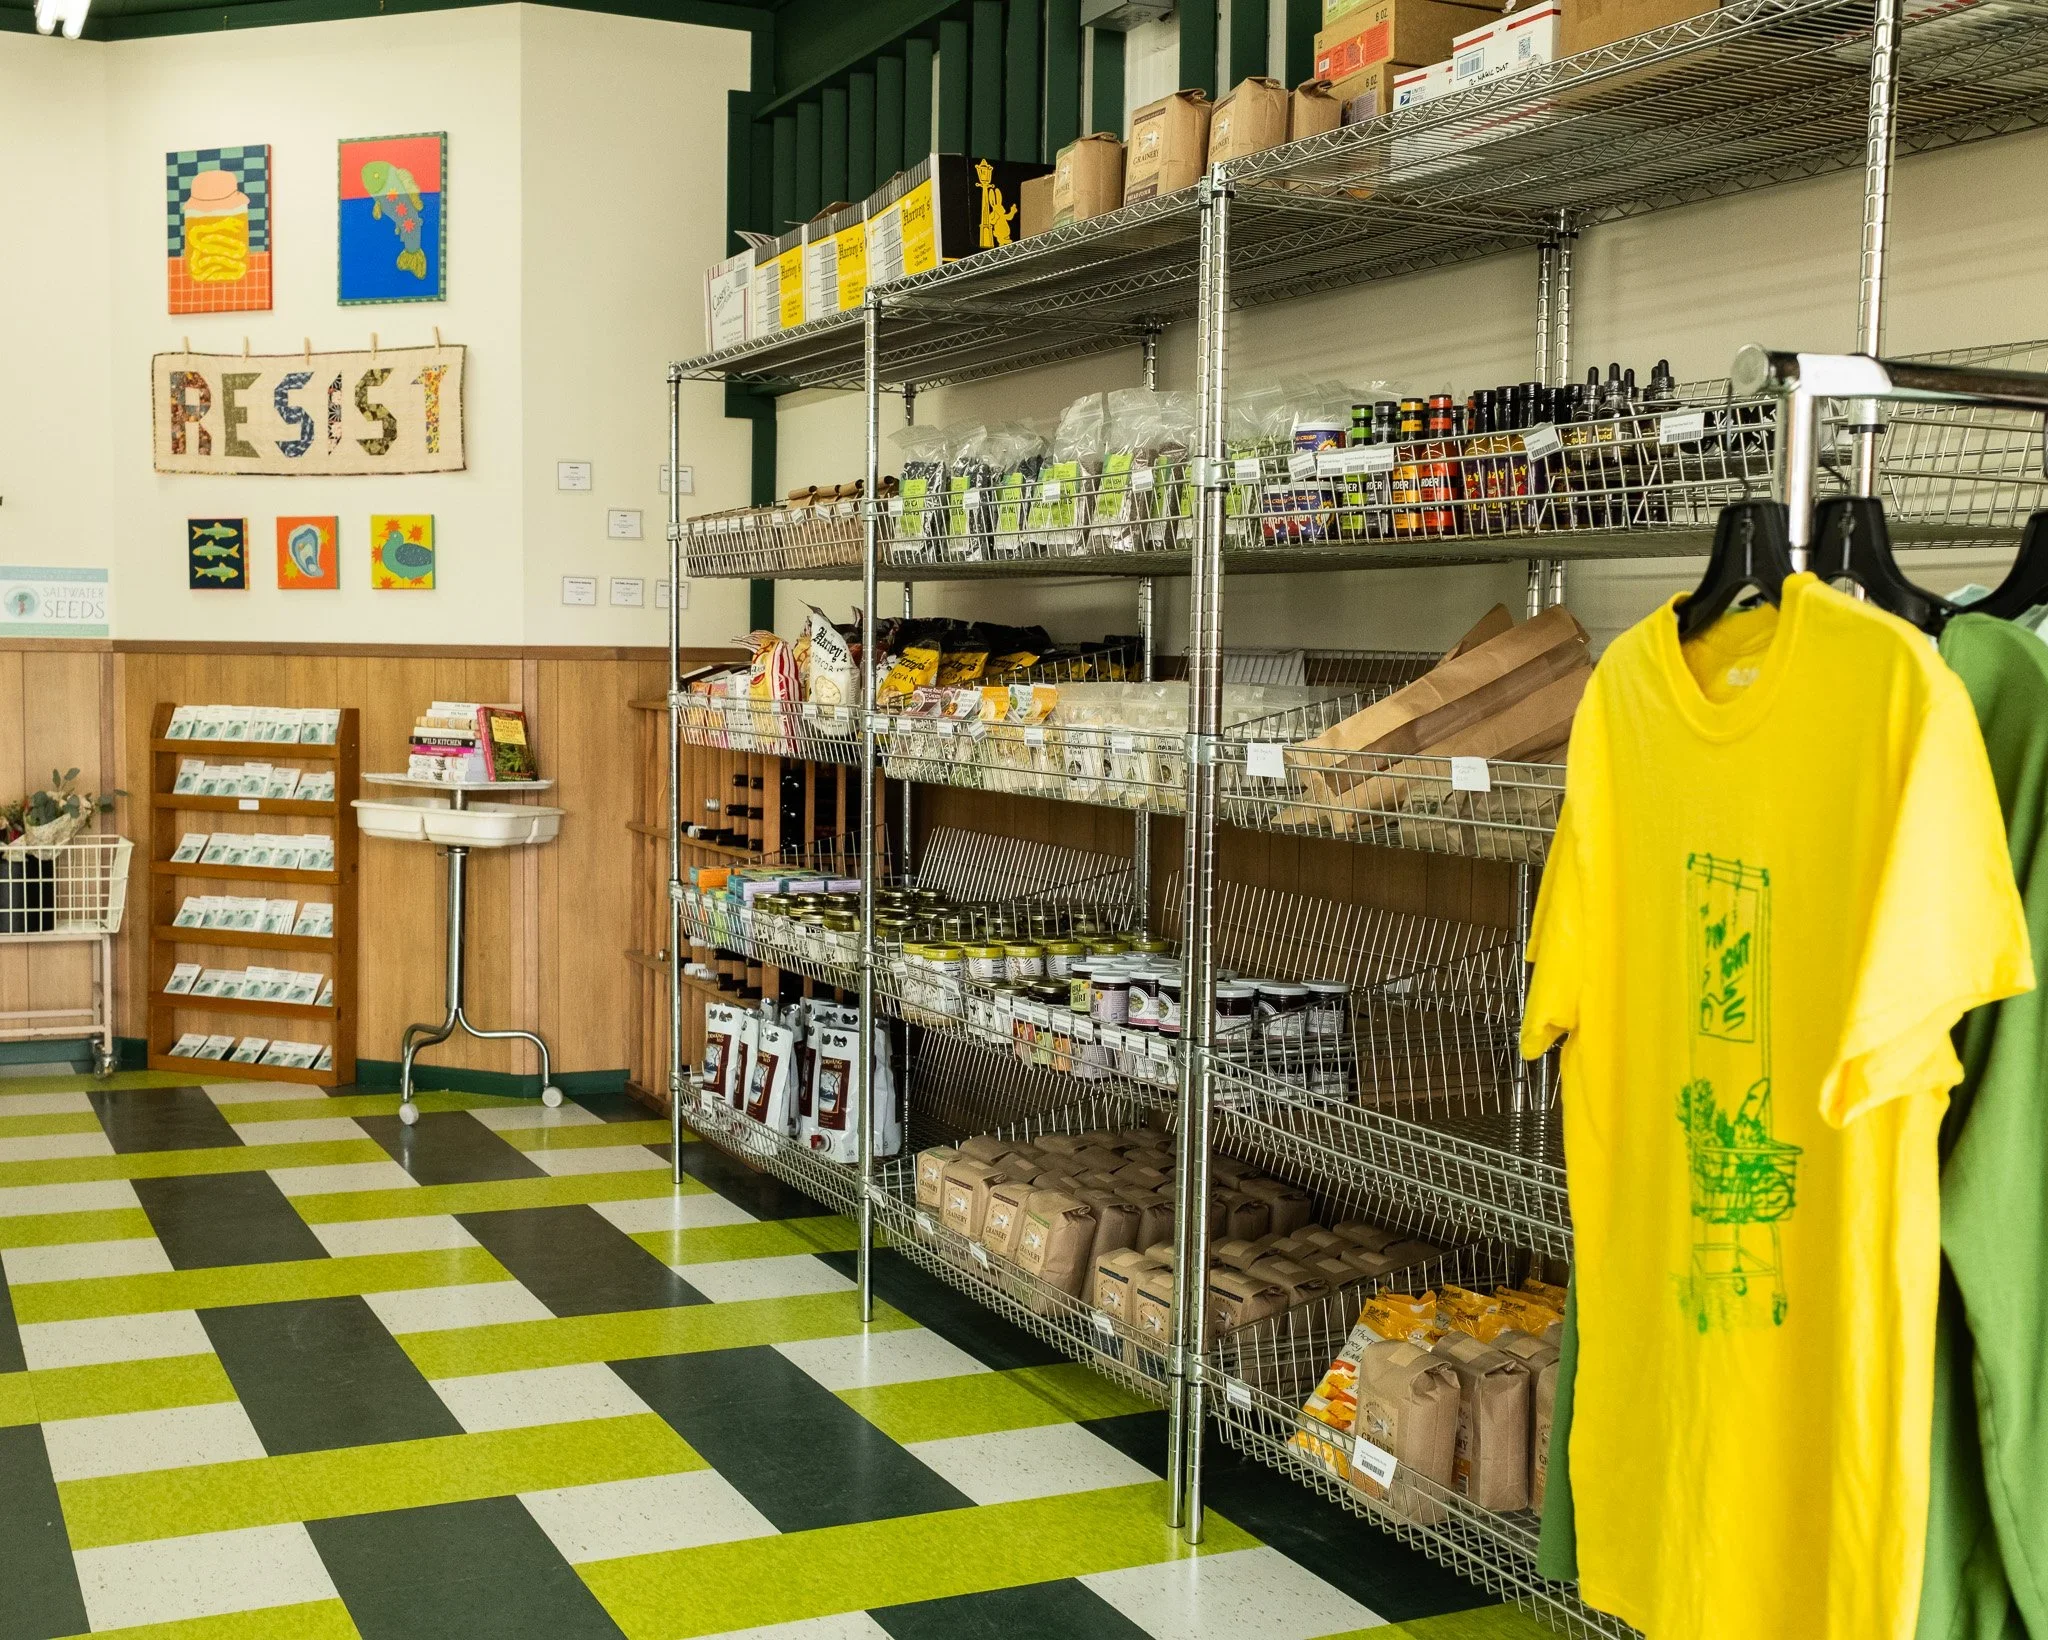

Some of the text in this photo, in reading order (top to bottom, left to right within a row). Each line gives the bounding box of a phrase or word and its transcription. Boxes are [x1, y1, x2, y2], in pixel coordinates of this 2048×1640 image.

[1132, 148, 1160, 165] GRAINERY
[169, 364, 450, 458] RESIST
[42, 586, 105, 598] SALTWATER
[43, 600, 105, 619] SEEDS
[422, 737, 462, 746] WILD KITCHEN
